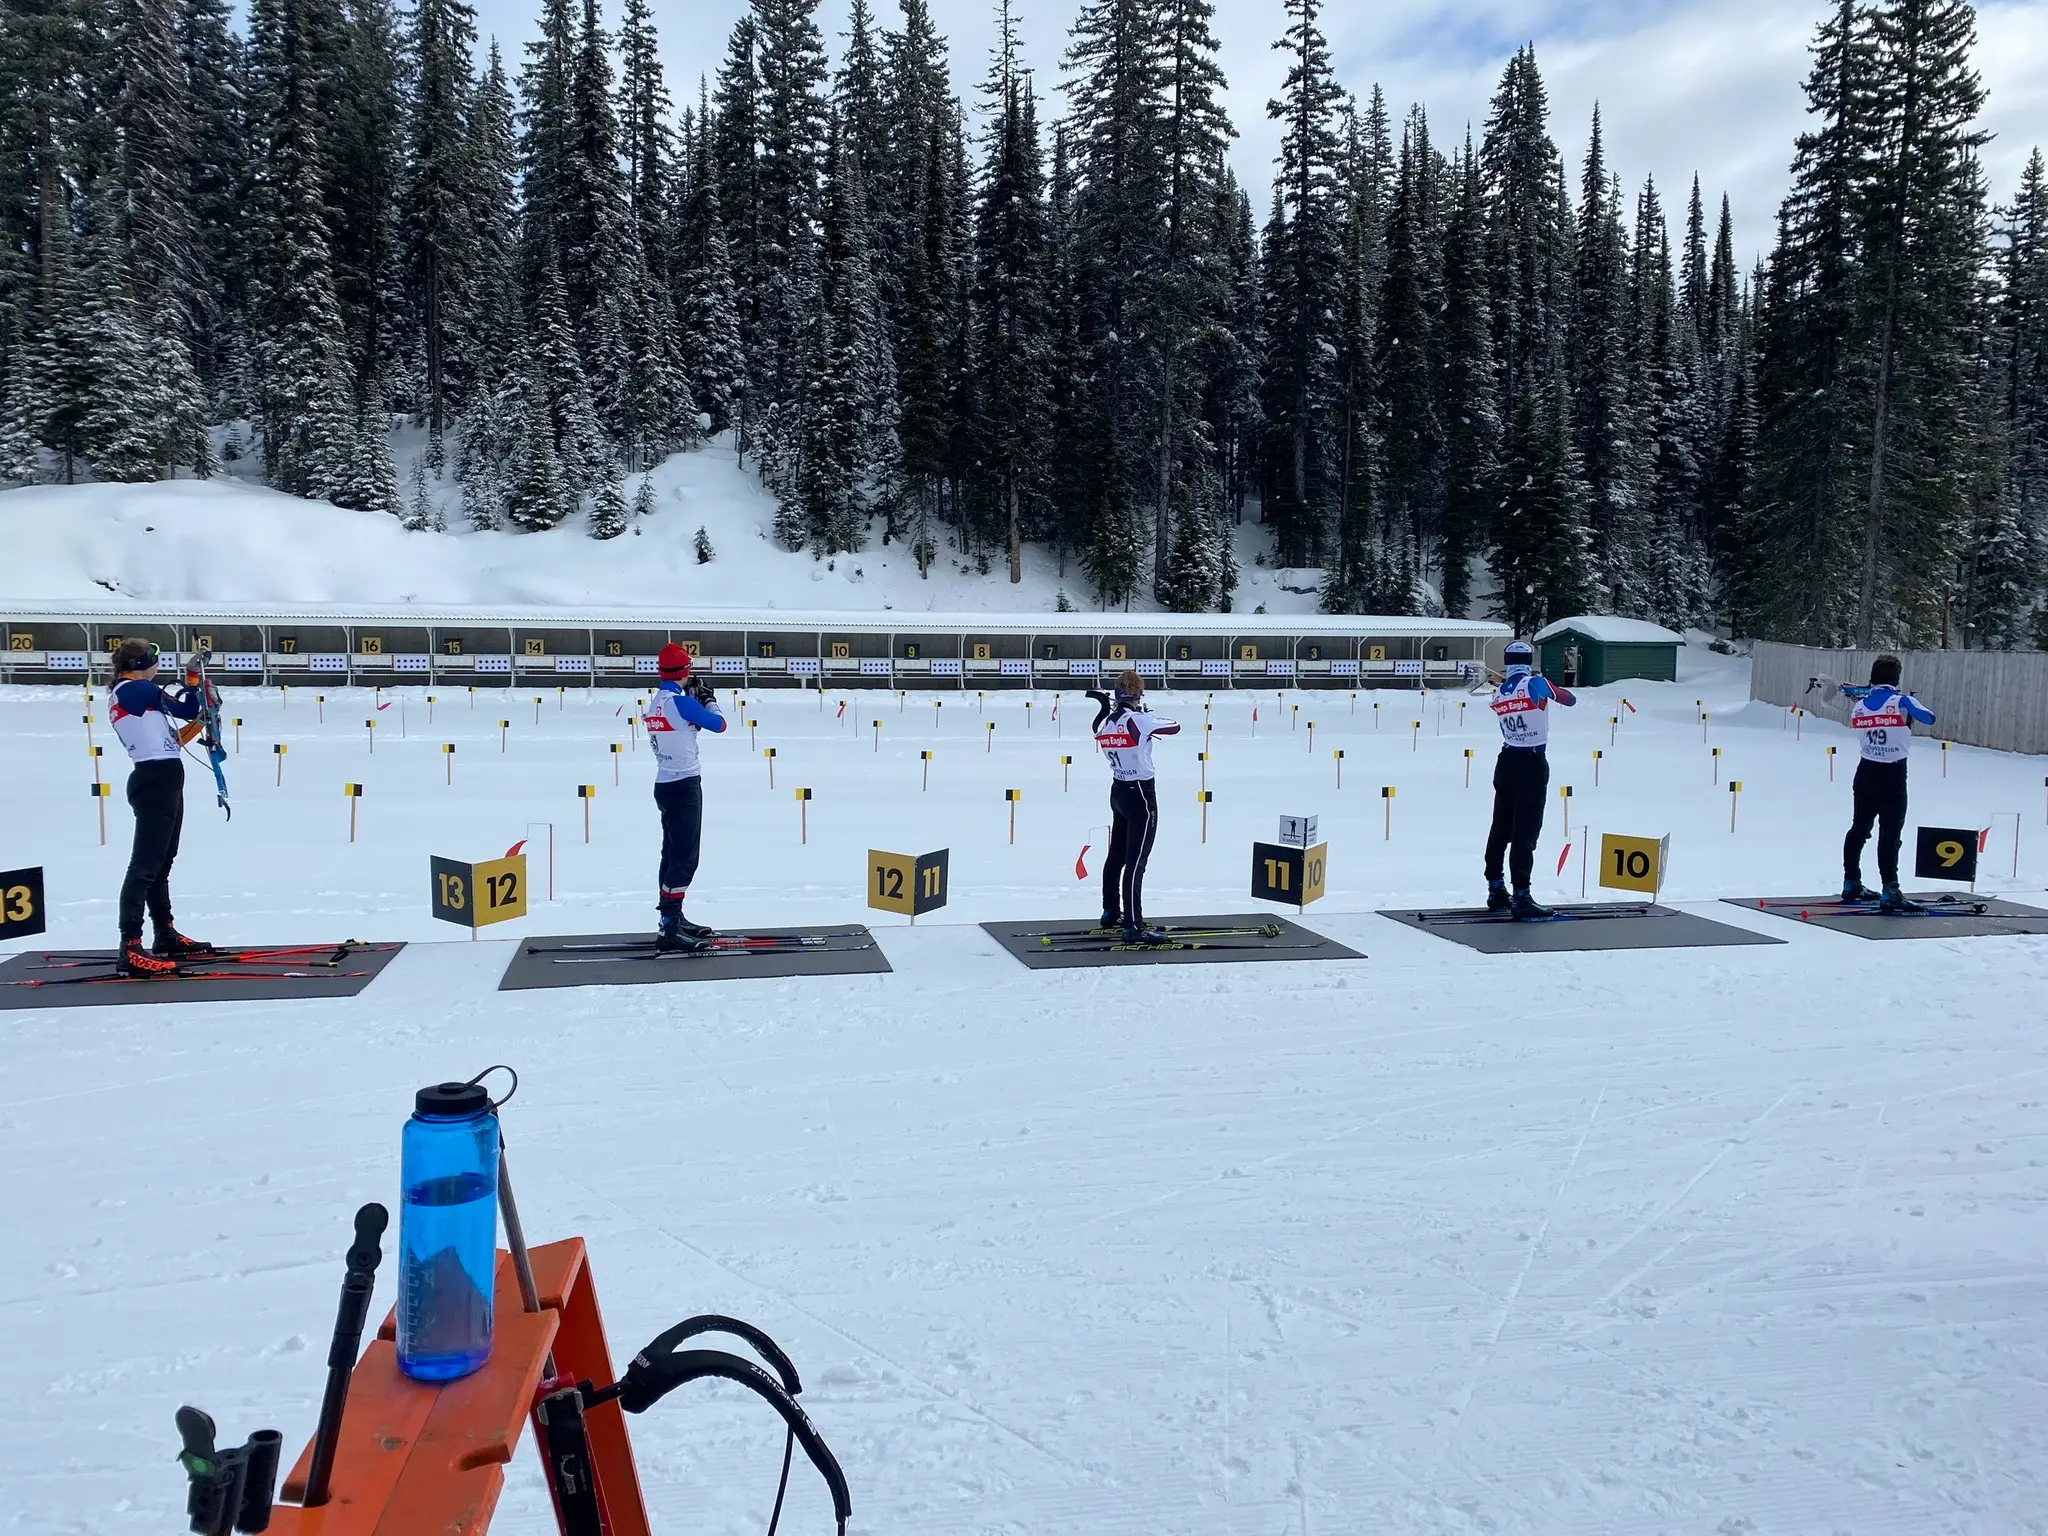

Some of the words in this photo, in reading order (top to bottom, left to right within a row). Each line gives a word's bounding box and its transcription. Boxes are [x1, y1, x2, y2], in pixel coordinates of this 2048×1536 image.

[11, 637, 33, 650] 20
[282, 639, 296, 652] 17
[364, 640, 379, 652] 16
[446, 641, 461, 654] 15
[527, 641, 542, 654] 14
[607, 642, 621, 655] 13
[685, 643, 698, 656] 12
[760, 644, 773, 656] 11
[834, 645, 848, 657] 10
[907, 646, 916, 657] 9
[978, 646, 986, 657] 8
[1047, 647, 1054, 659] 7
[1114, 646, 1122, 659] 6
[1180, 647, 1188, 659] 5
[1245, 648, 1254, 659] 4
[1311, 648, 1317, 659] 3
[1374, 648, 1381, 660] 2
[1438, 648, 1444, 659] 1
[1508, 700, 1529, 711] Eagle
[1503, 714, 1527, 732] 104
[1856, 717, 1873, 727] Jeep
[1875, 717, 1897, 727] Eagle
[1110, 736, 1127, 746] Eagle
[1866, 729, 1887, 745] 119
[1935, 840, 1965, 868] 9
[1613, 849, 1650, 879] 10
[1264, 858, 1290, 891] 11
[1307, 858, 1323, 889] 10
[876, 866, 904, 899] 12
[922, 865, 941, 898] 11
[438, 874, 465, 909] 13
[487, 872, 518, 909] 12
[1110, 943, 1185, 952] FISCHER
